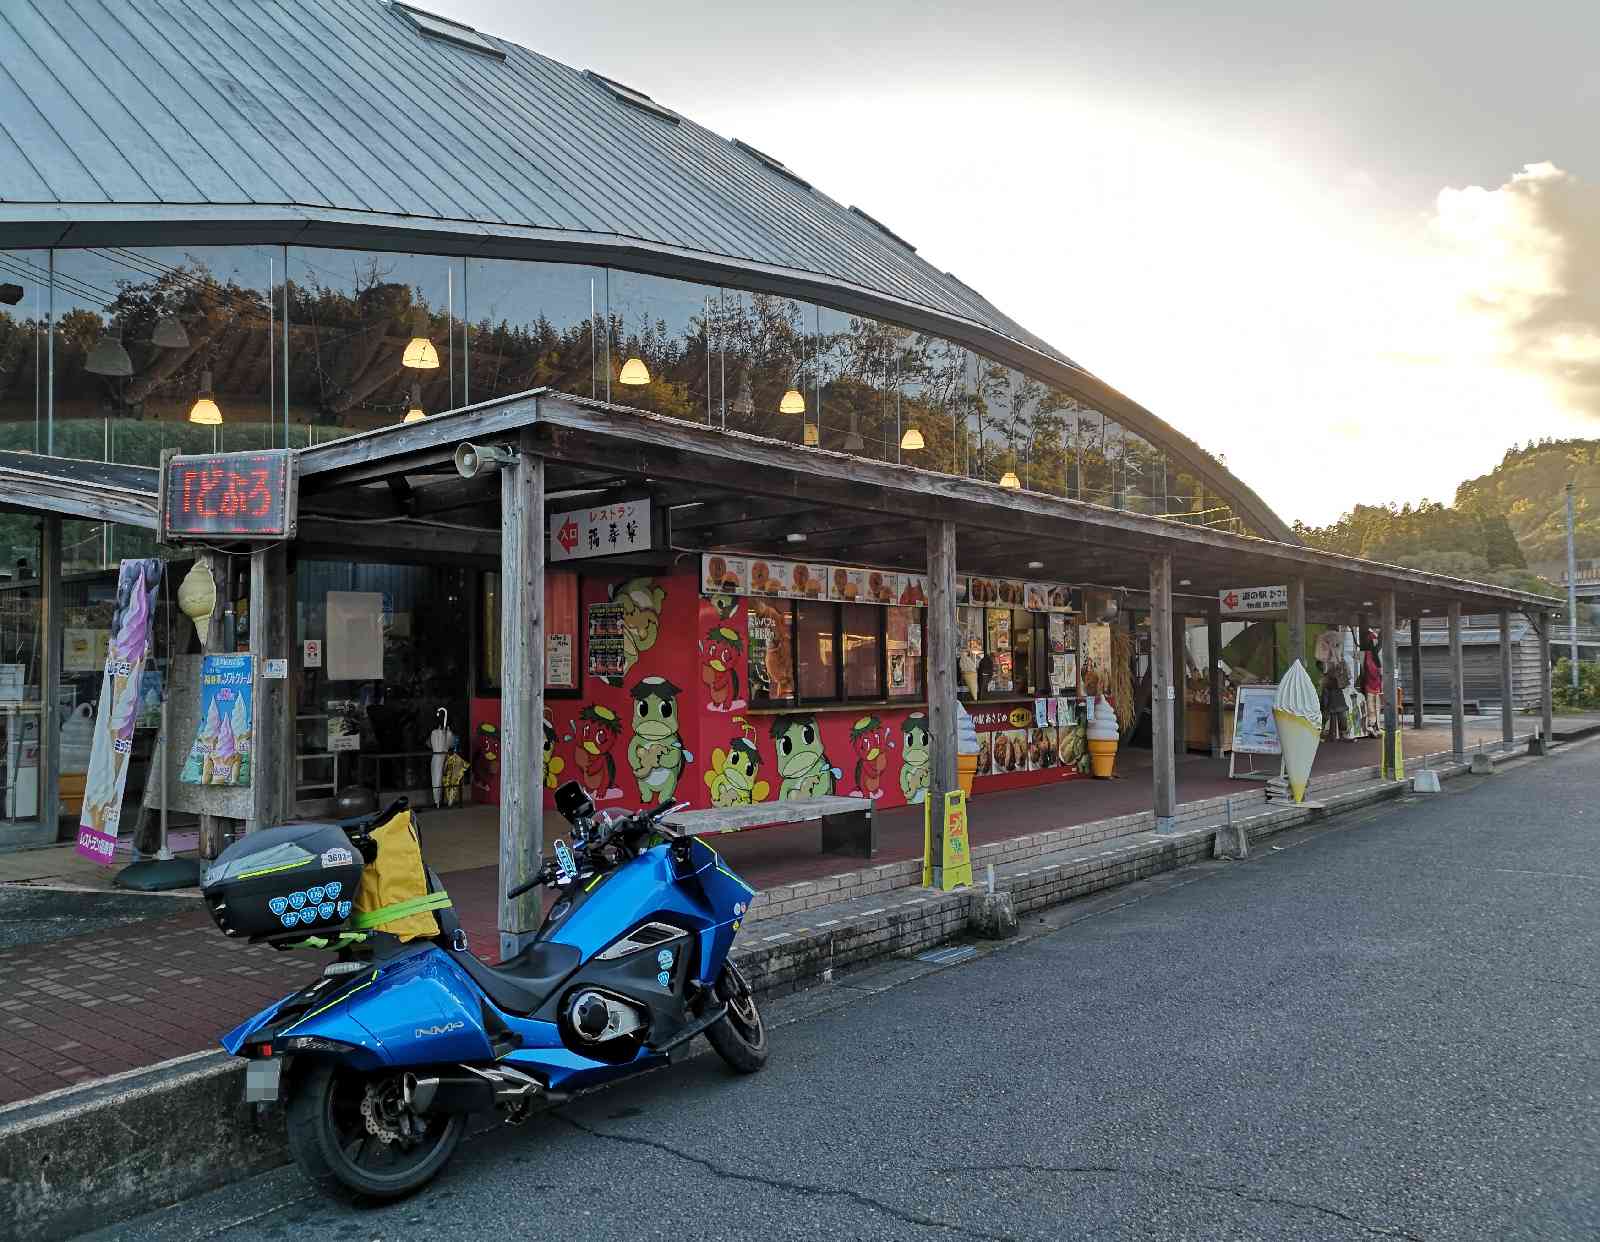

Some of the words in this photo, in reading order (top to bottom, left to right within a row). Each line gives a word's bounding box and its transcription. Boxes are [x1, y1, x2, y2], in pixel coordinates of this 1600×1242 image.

[590, 504, 635, 522] レストラン
[560, 527, 577, 542] 入口
